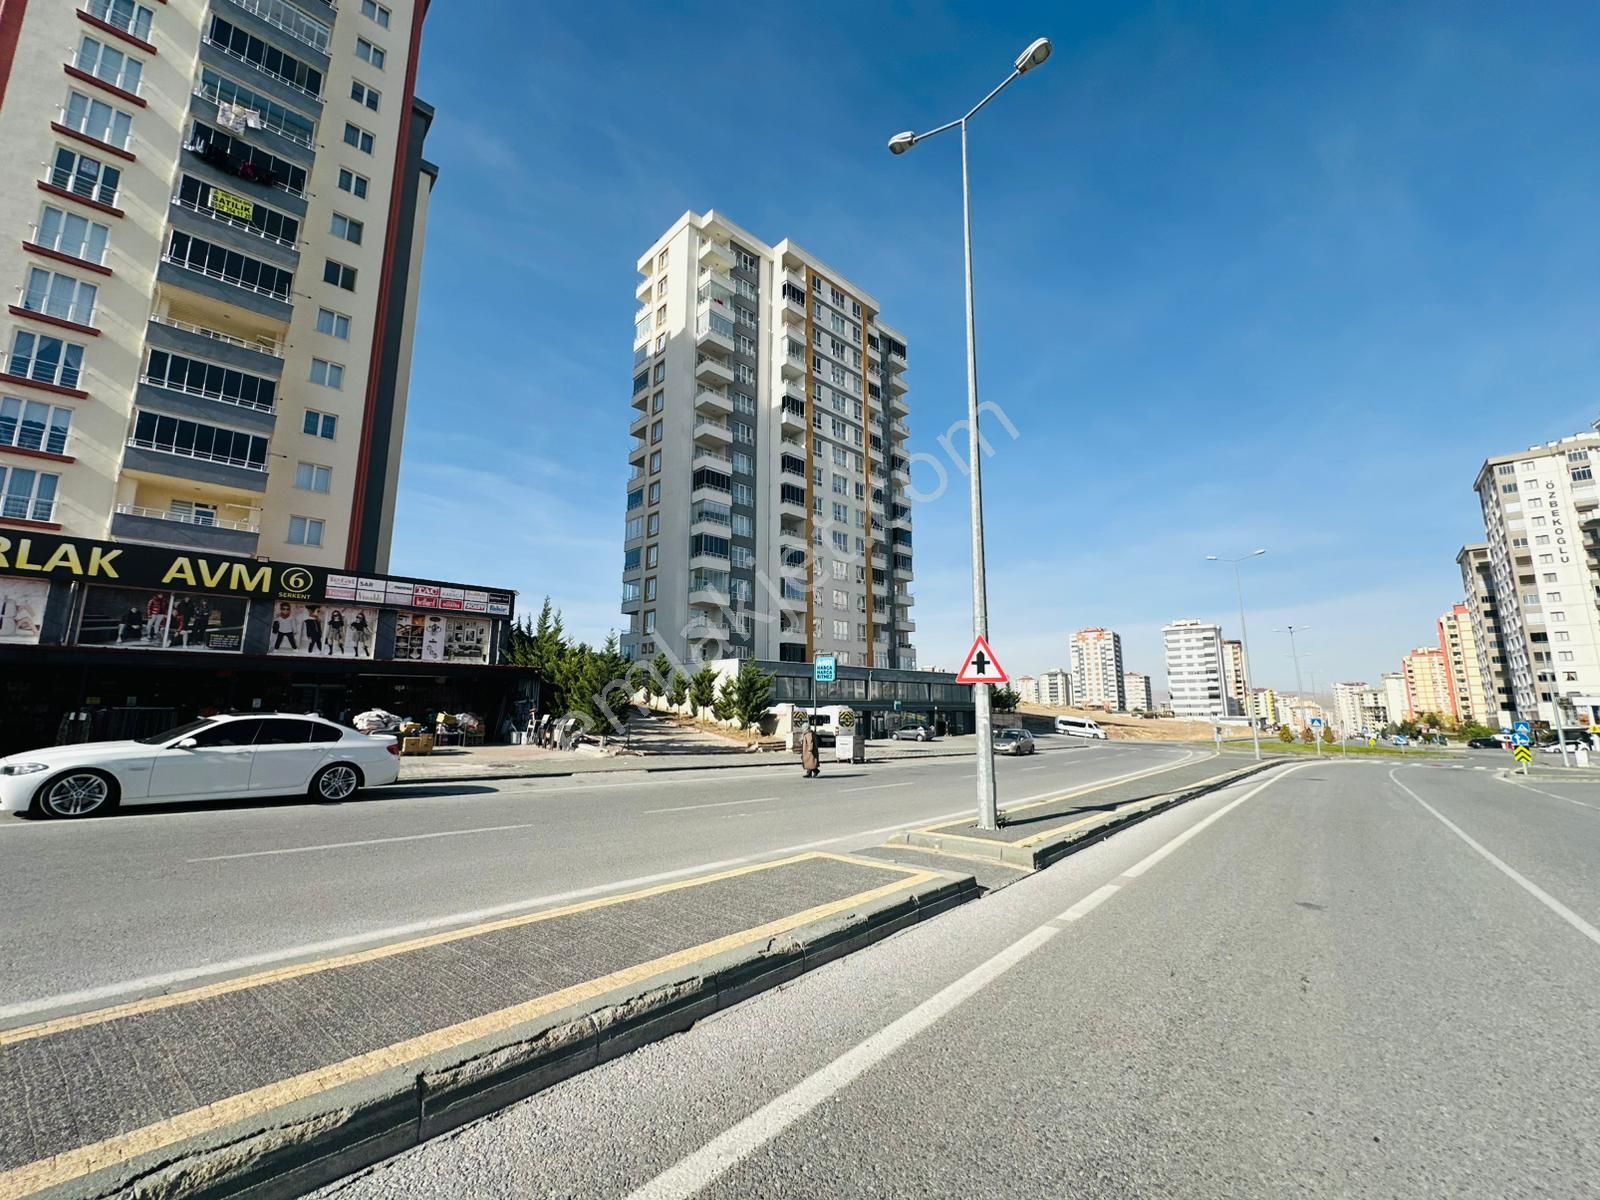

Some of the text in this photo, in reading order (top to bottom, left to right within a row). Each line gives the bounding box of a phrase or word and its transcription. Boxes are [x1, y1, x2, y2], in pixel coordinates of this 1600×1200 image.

[213, 195, 250, 213] SATILIK
[162, 556, 272, 593] AVM
[289, 572, 305, 588] 6
[278, 591, 312, 600] SERKENT
